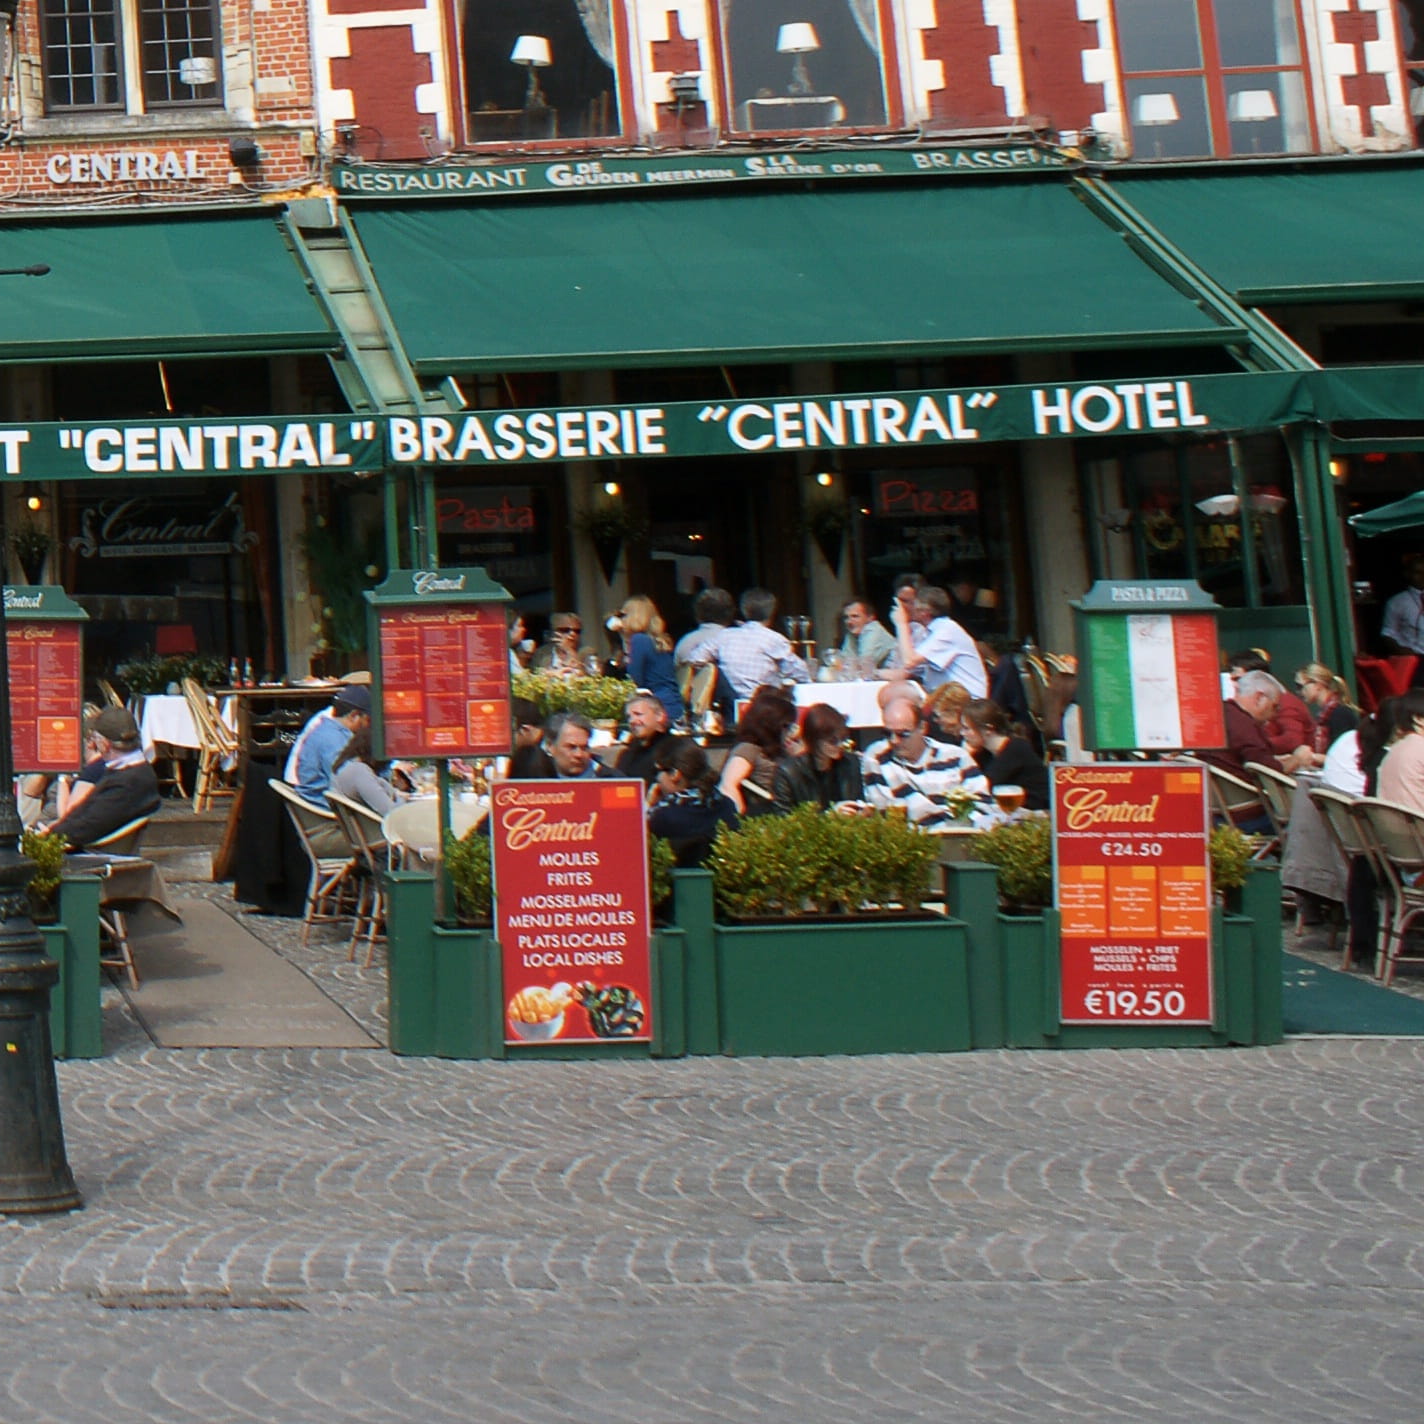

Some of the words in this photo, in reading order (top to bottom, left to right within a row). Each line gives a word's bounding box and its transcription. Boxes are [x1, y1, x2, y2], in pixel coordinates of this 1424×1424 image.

[47, 149, 206, 185] CENTRAL
[576, 162, 602, 174] DE
[340, 168, 527, 192] RESTAURANT
[389, 407, 666, 464] BRASSERIE
[1032, 380, 1208, 436] HOTEL
[879, 479, 980, 513] Pizza
[436, 495, 536, 532] Pasta
[1111, 587, 1145, 602] PASTA
[1054, 767, 1133, 785] Restaurant
[495, 788, 575, 807] Restaurant
[1063, 787, 1160, 831] Central
[502, 807, 598, 851] Central
[1100, 842, 1163, 856] €24.50
[539, 852, 600, 867] MOULES
[547, 872, 593, 886] FRITES
[521, 893, 622, 909] MOSSELMENU
[508, 914, 552, 928] MENU
[554, 913, 573, 926] DE
[575, 910, 636, 926] MOULES
[518, 934, 561, 948] PLATS
[561, 932, 627, 947] LOCALES
[522, 953, 571, 967] LOCAL
[574, 951, 624, 966] DISHES
[1084, 989, 1186, 1017] €19.50
